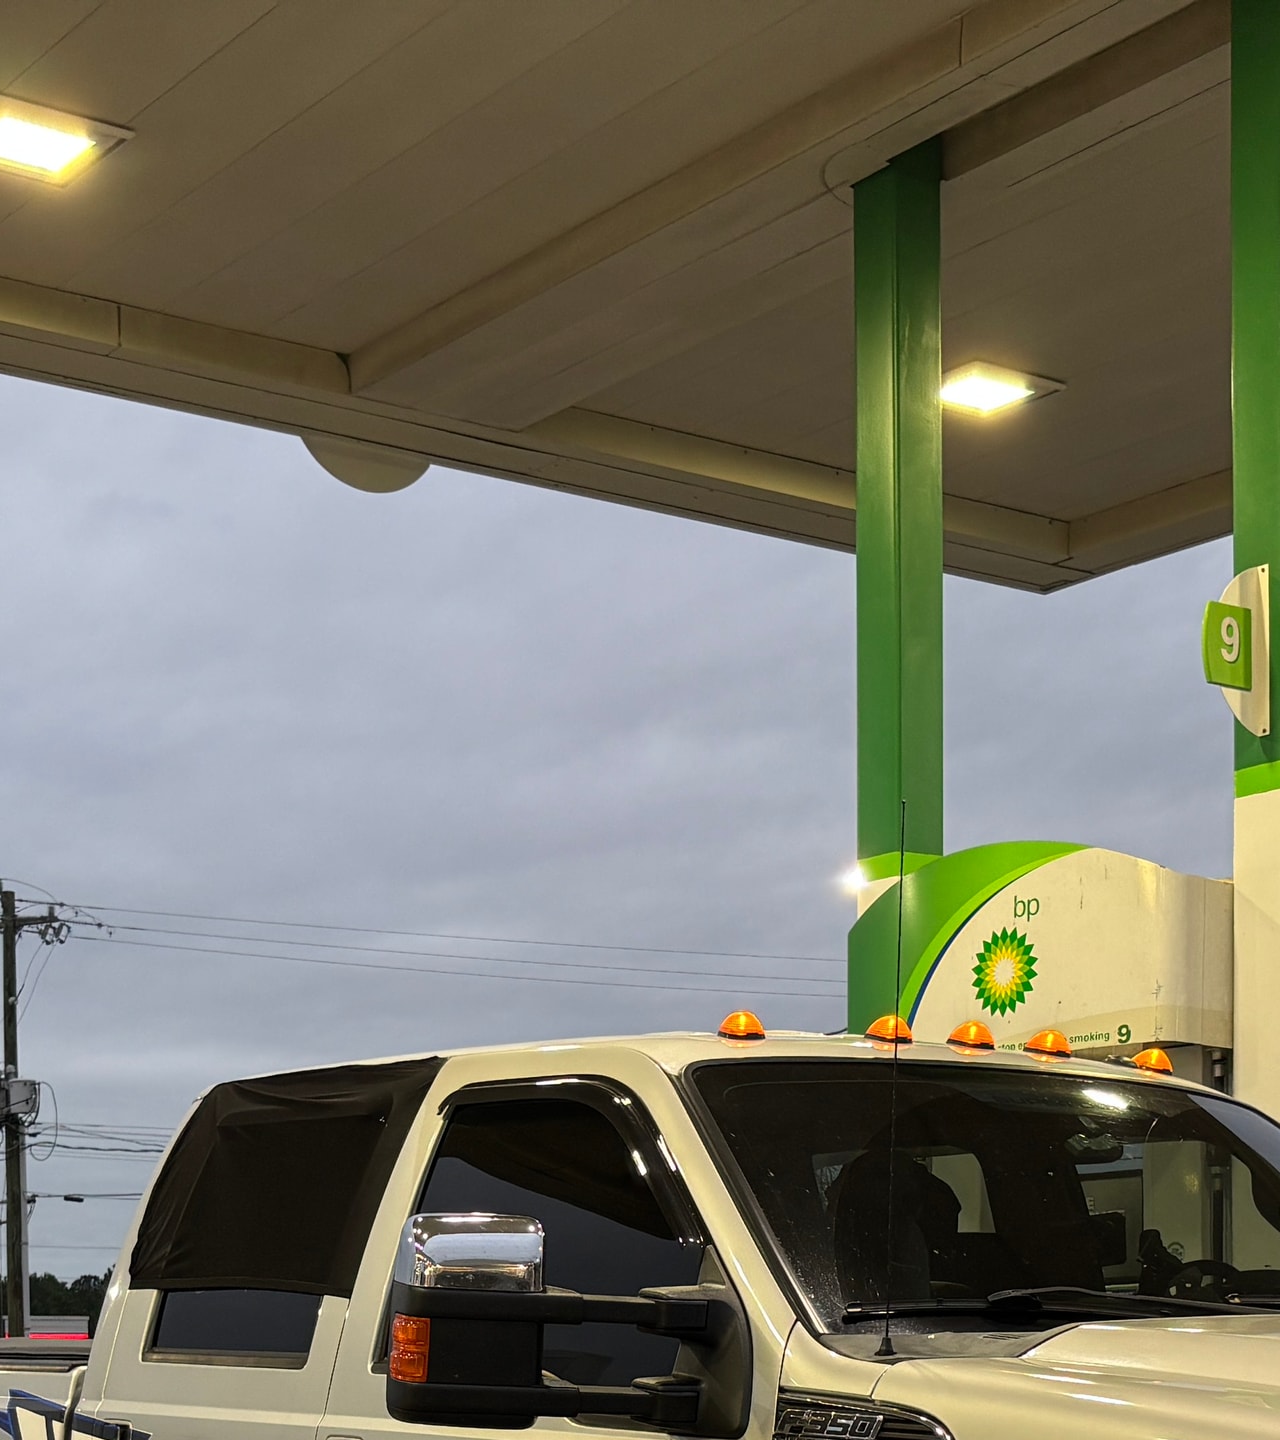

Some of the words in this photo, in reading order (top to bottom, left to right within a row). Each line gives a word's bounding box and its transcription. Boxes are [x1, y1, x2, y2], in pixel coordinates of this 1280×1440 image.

[1221, 617, 1240, 663] 9
[1014, 895, 1040, 922] bp
[1069, 1031, 1110, 1043] smoking
[1117, 1024, 1131, 1043] 9
